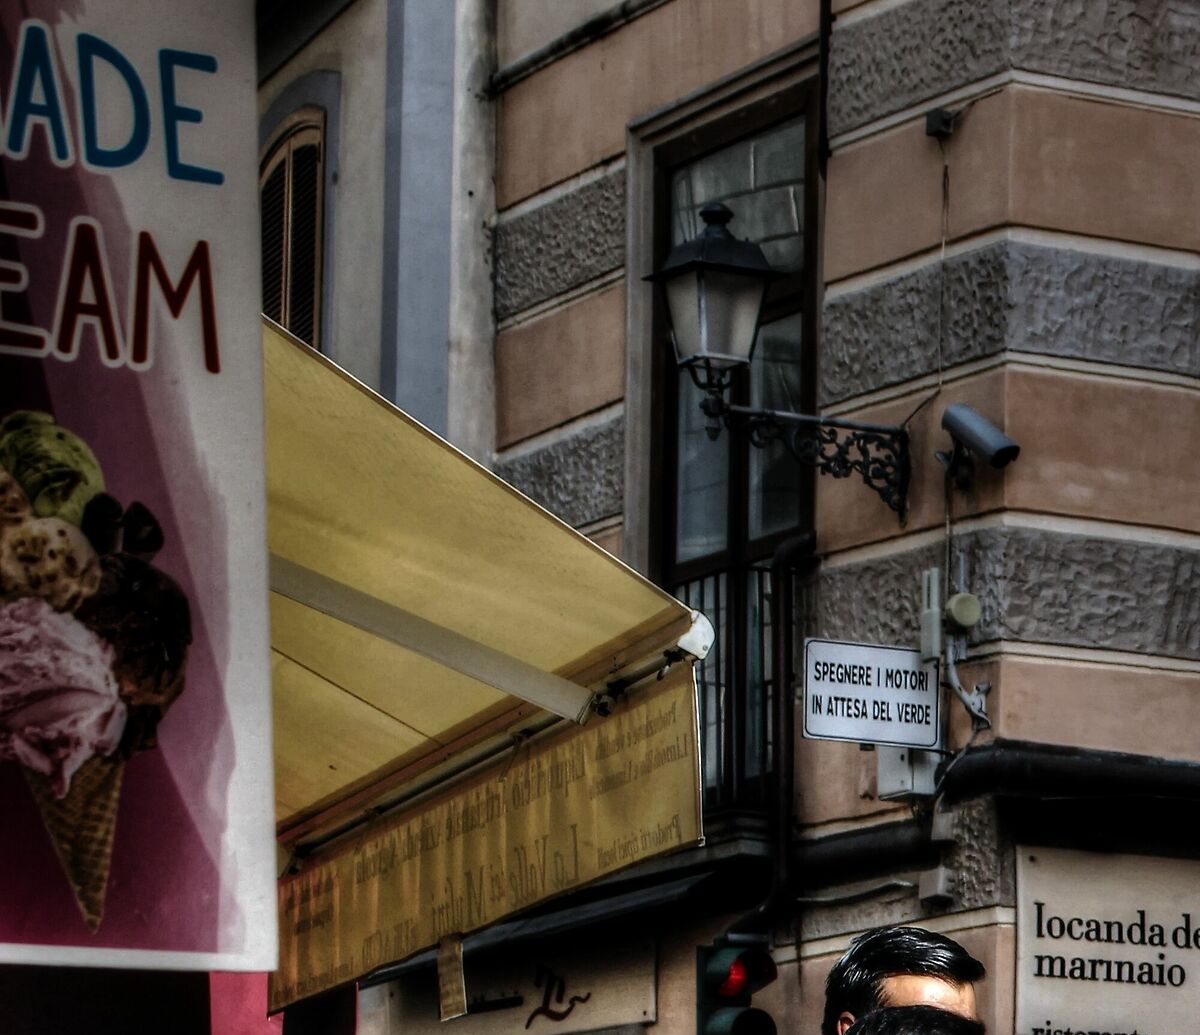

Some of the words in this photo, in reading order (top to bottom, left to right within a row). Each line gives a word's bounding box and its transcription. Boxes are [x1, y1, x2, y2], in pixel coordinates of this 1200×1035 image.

[814, 661, 872, 687] SPEGNERE
[876, 667, 881, 687] I
[885, 668, 929, 692] MOTORI
[812, 694, 822, 715] IN
[826, 696, 868, 719] ATTESA
[873, 701, 892, 722] DEL
[897, 702, 931, 725] VERDE
[1034, 902, 1168, 947] locanda
[1034, 953, 1186, 987] marinaio
